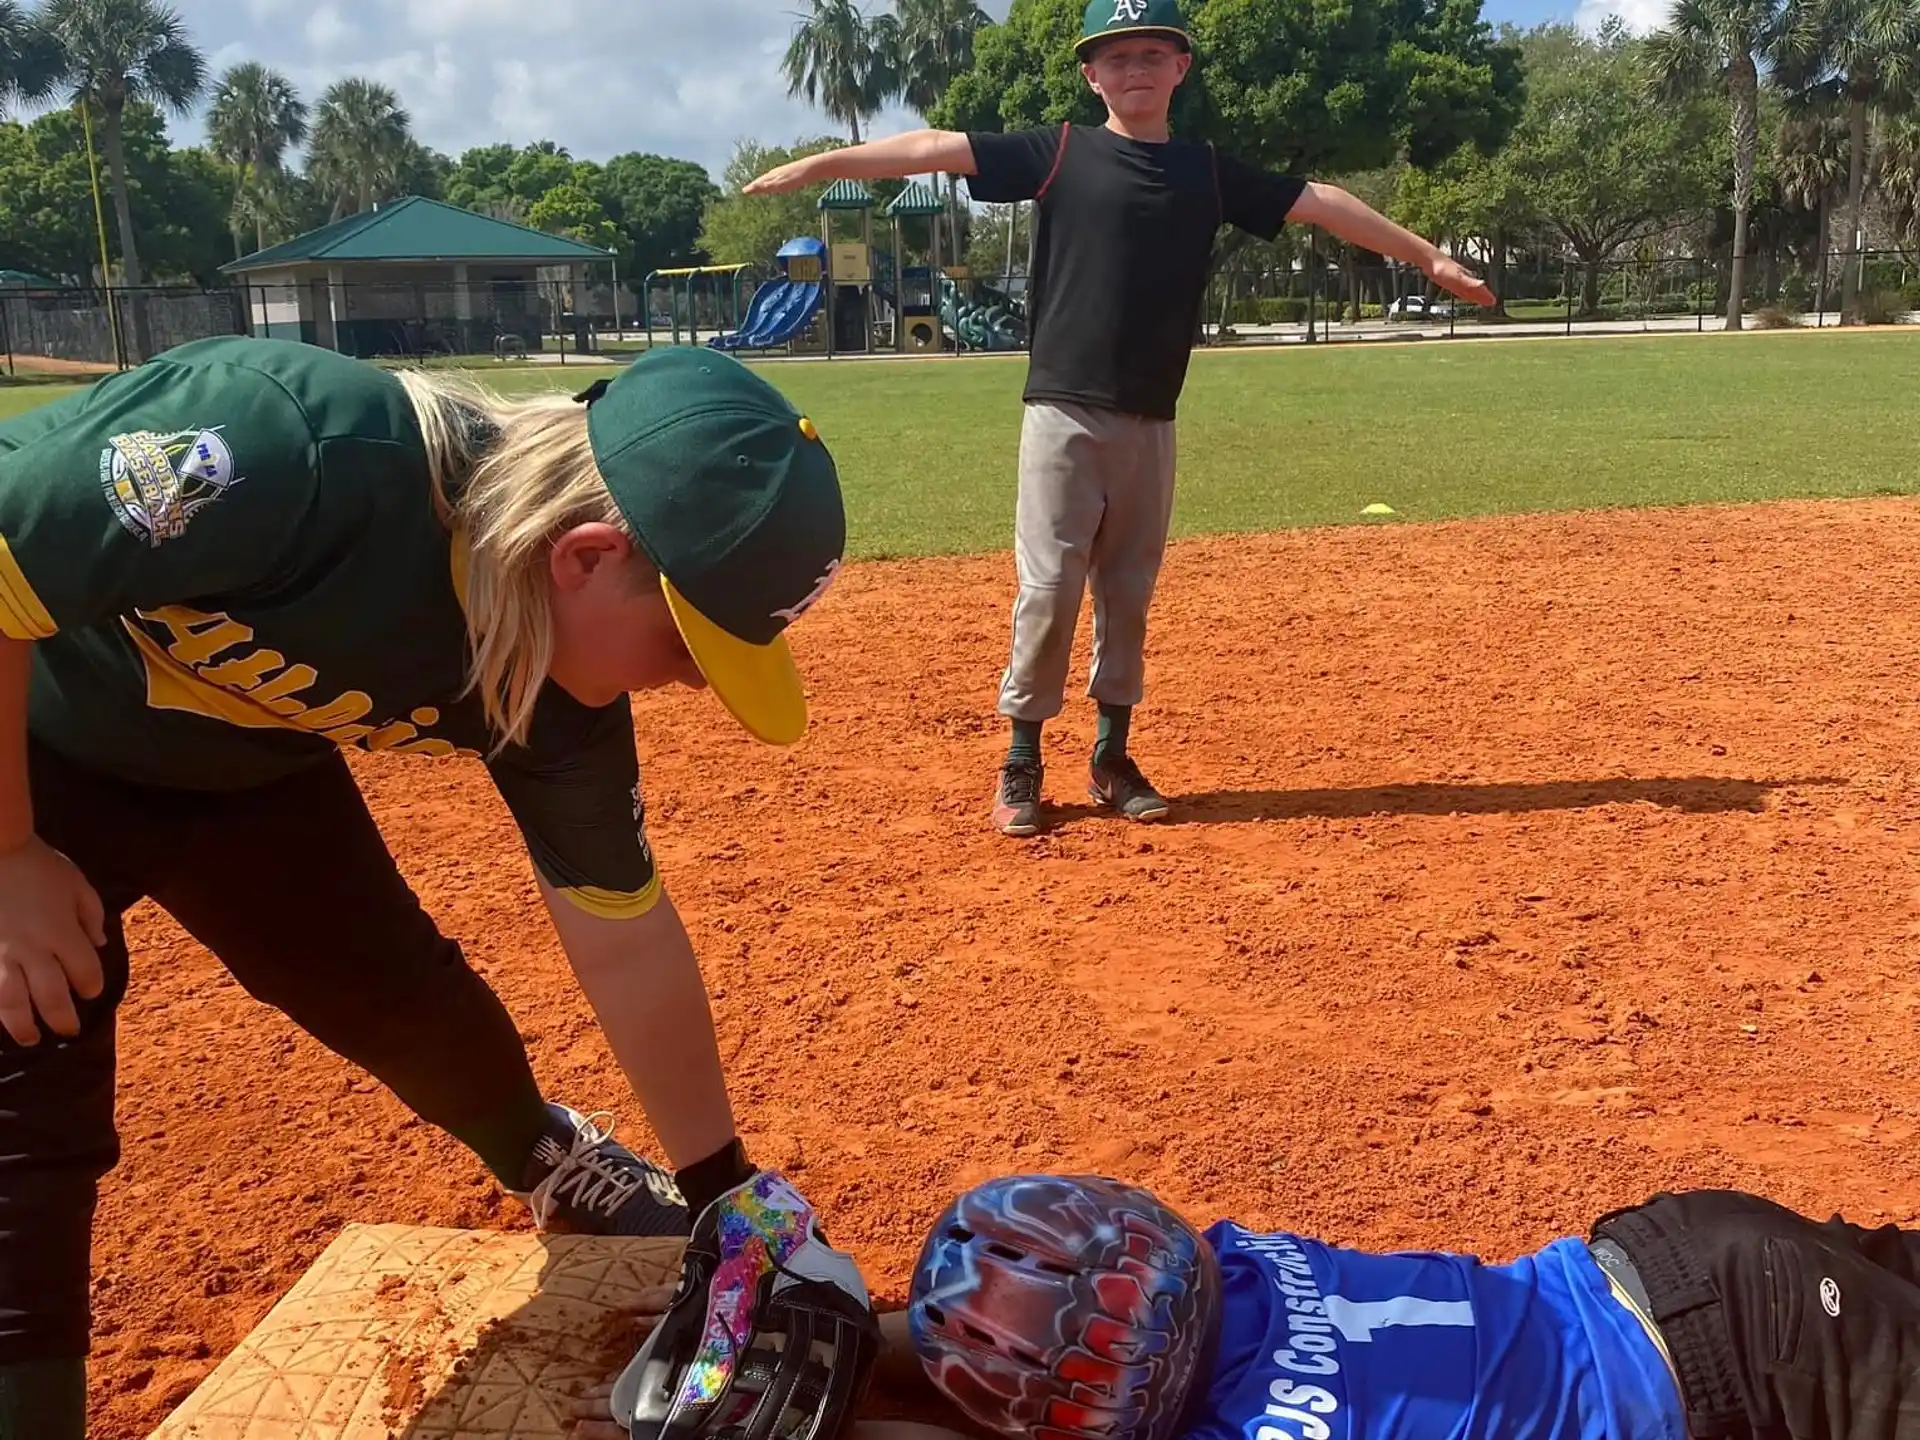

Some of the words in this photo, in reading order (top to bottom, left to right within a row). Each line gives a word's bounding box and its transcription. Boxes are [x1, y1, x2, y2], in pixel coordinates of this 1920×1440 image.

[114, 435, 172, 547] BASEBALL
[131, 429, 186, 537] GARDENS
[1322, 1294, 1476, 1343] 1
